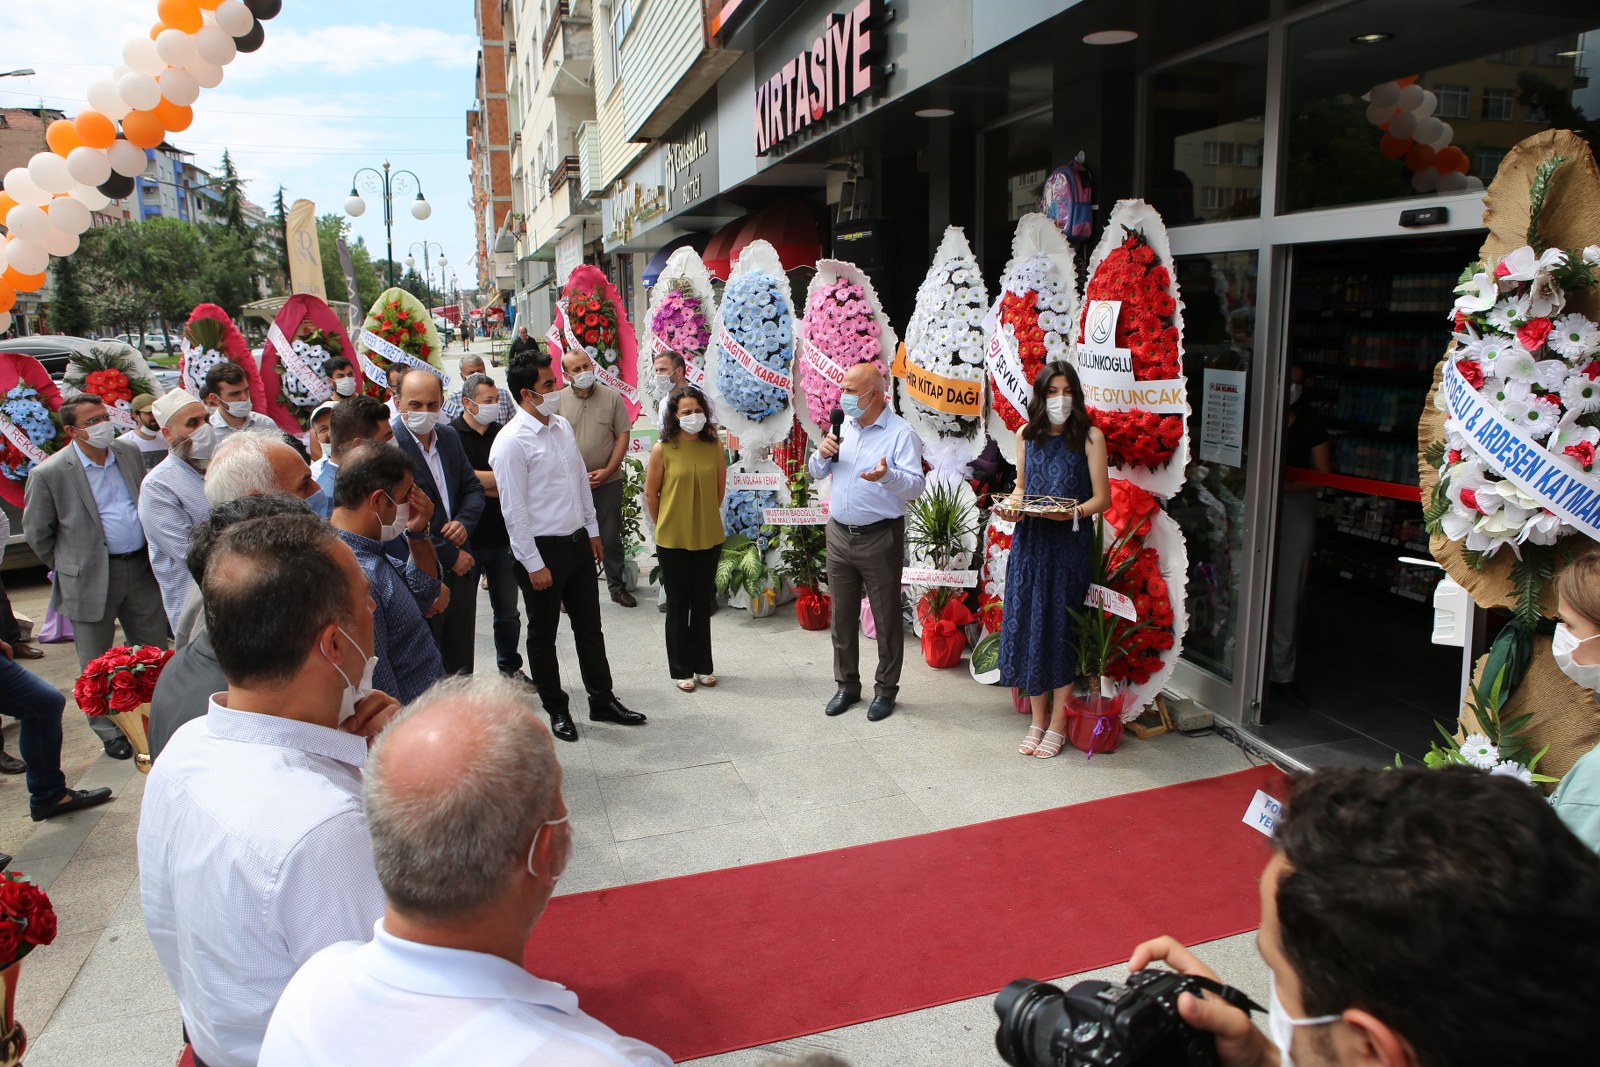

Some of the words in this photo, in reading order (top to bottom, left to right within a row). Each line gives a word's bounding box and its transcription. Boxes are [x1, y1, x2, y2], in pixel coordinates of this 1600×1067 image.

[753, 0, 872, 157] KIRTASİYE
[918, 375, 944, 400] KİTAP
[946, 386, 980, 406] DAĞI
[1102, 387, 1184, 406] OYUNCAK
[1464, 406, 1484, 433] &
[1473, 417, 1547, 483] ARDEŞEN
